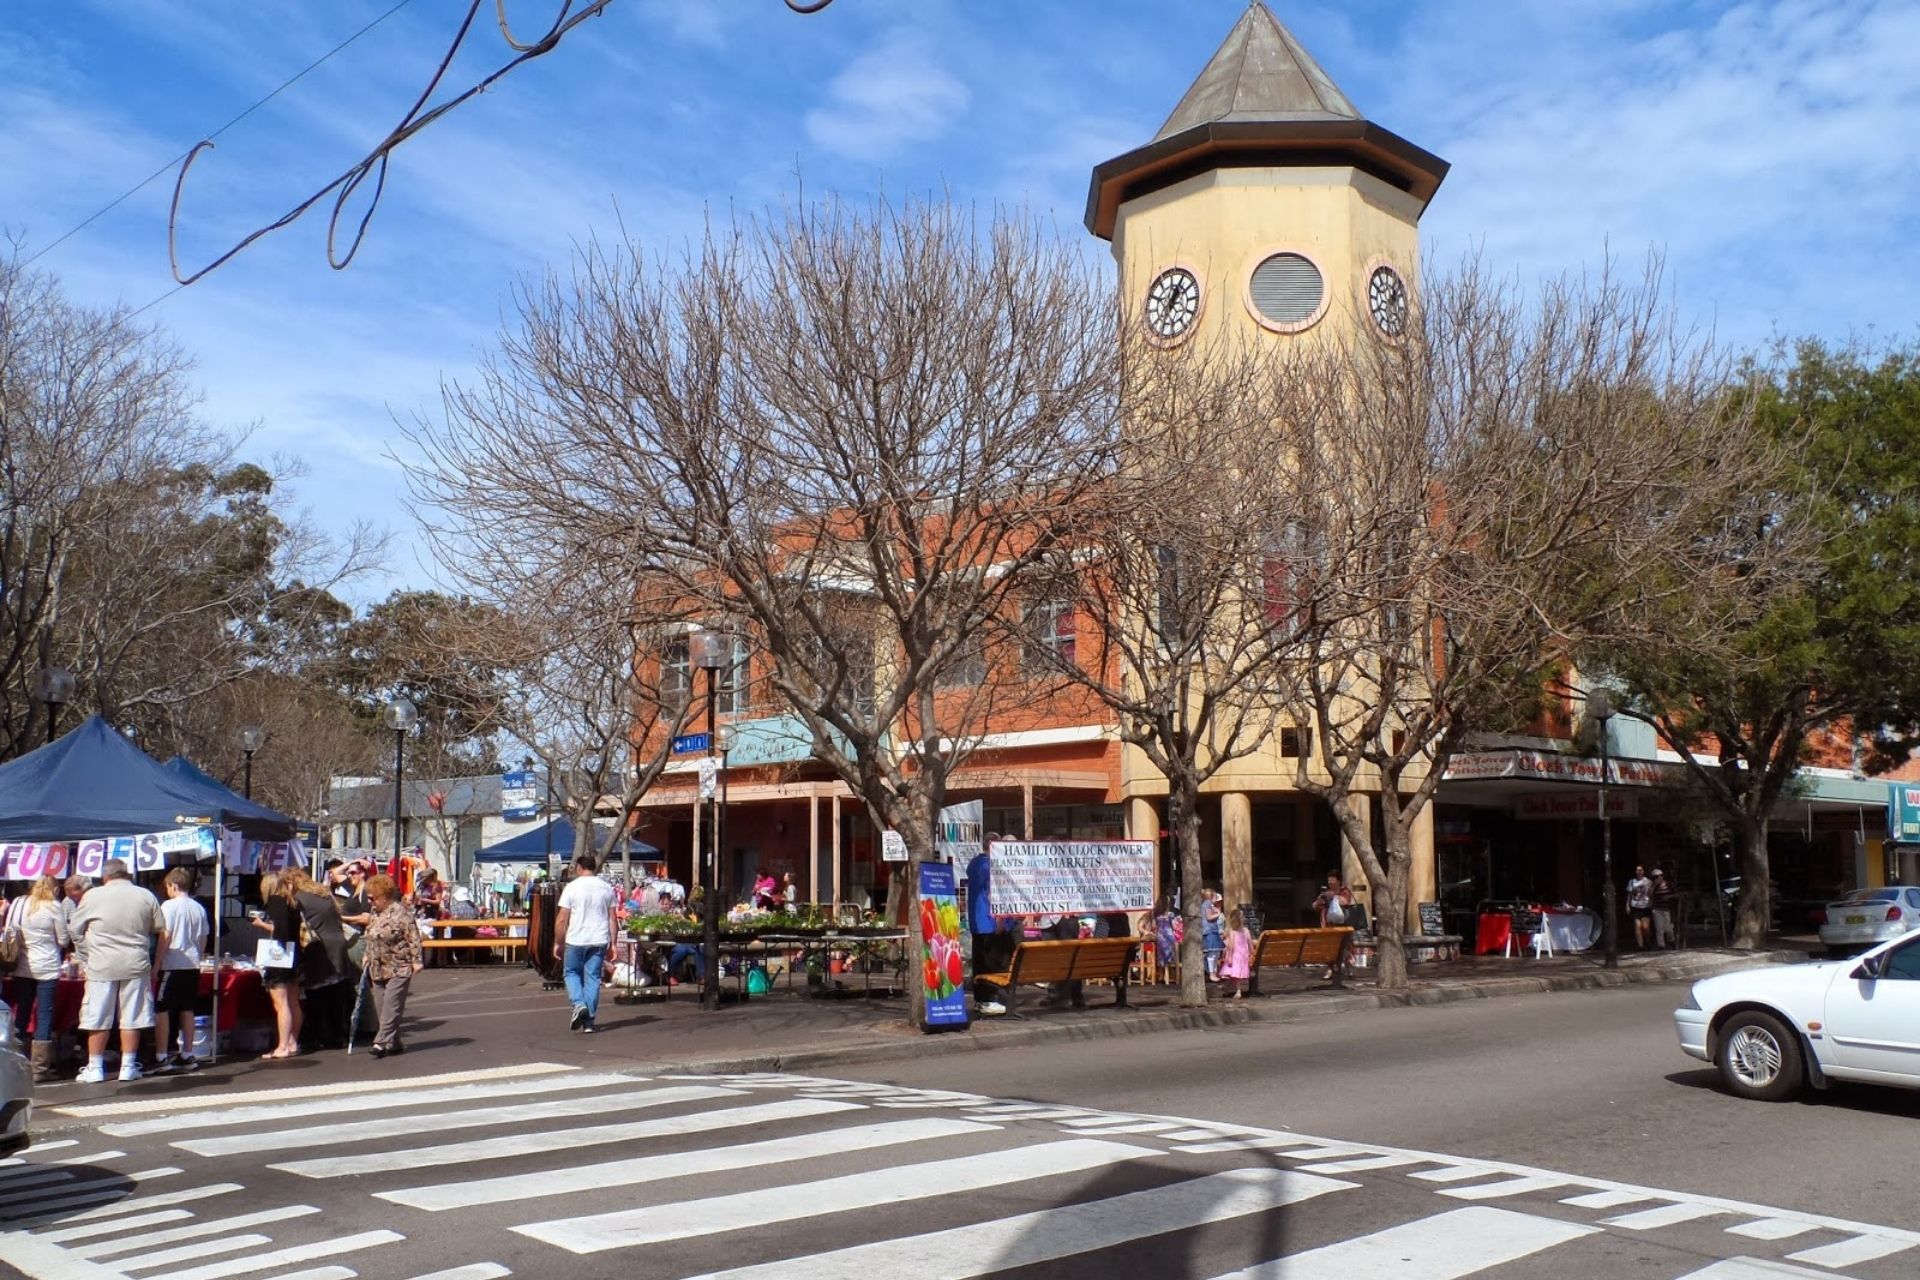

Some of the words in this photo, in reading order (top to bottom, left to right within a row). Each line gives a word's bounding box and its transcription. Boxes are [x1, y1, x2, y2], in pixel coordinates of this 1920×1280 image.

[1518, 754, 1564, 774] Clock
[935, 821, 981, 843] HAMILTON
[1004, 844, 1065, 856] HAMILTON
[1068, 844, 1143, 856] CLOCKTOWER
[990, 858, 1023, 868] PLANTS
[1049, 857, 1102, 869] MARKETS
[1084, 868, 1110, 877] EVERY
[1112, 868, 1152, 877] SATURDAY
[1046, 877, 1080, 885] FASHION
[1033, 886, 1053, 895] LIVE
[1054, 885, 1125, 895] ENTERTAINMENT
[1125, 886, 1152, 895] HERBS
[991, 902, 1056, 914] BEAUMONT
[1058, 901, 1072, 912] ST
[1122, 898, 1129, 908] 9
[1131, 895, 1144, 907] till
[1146, 898, 1152, 906] 2
